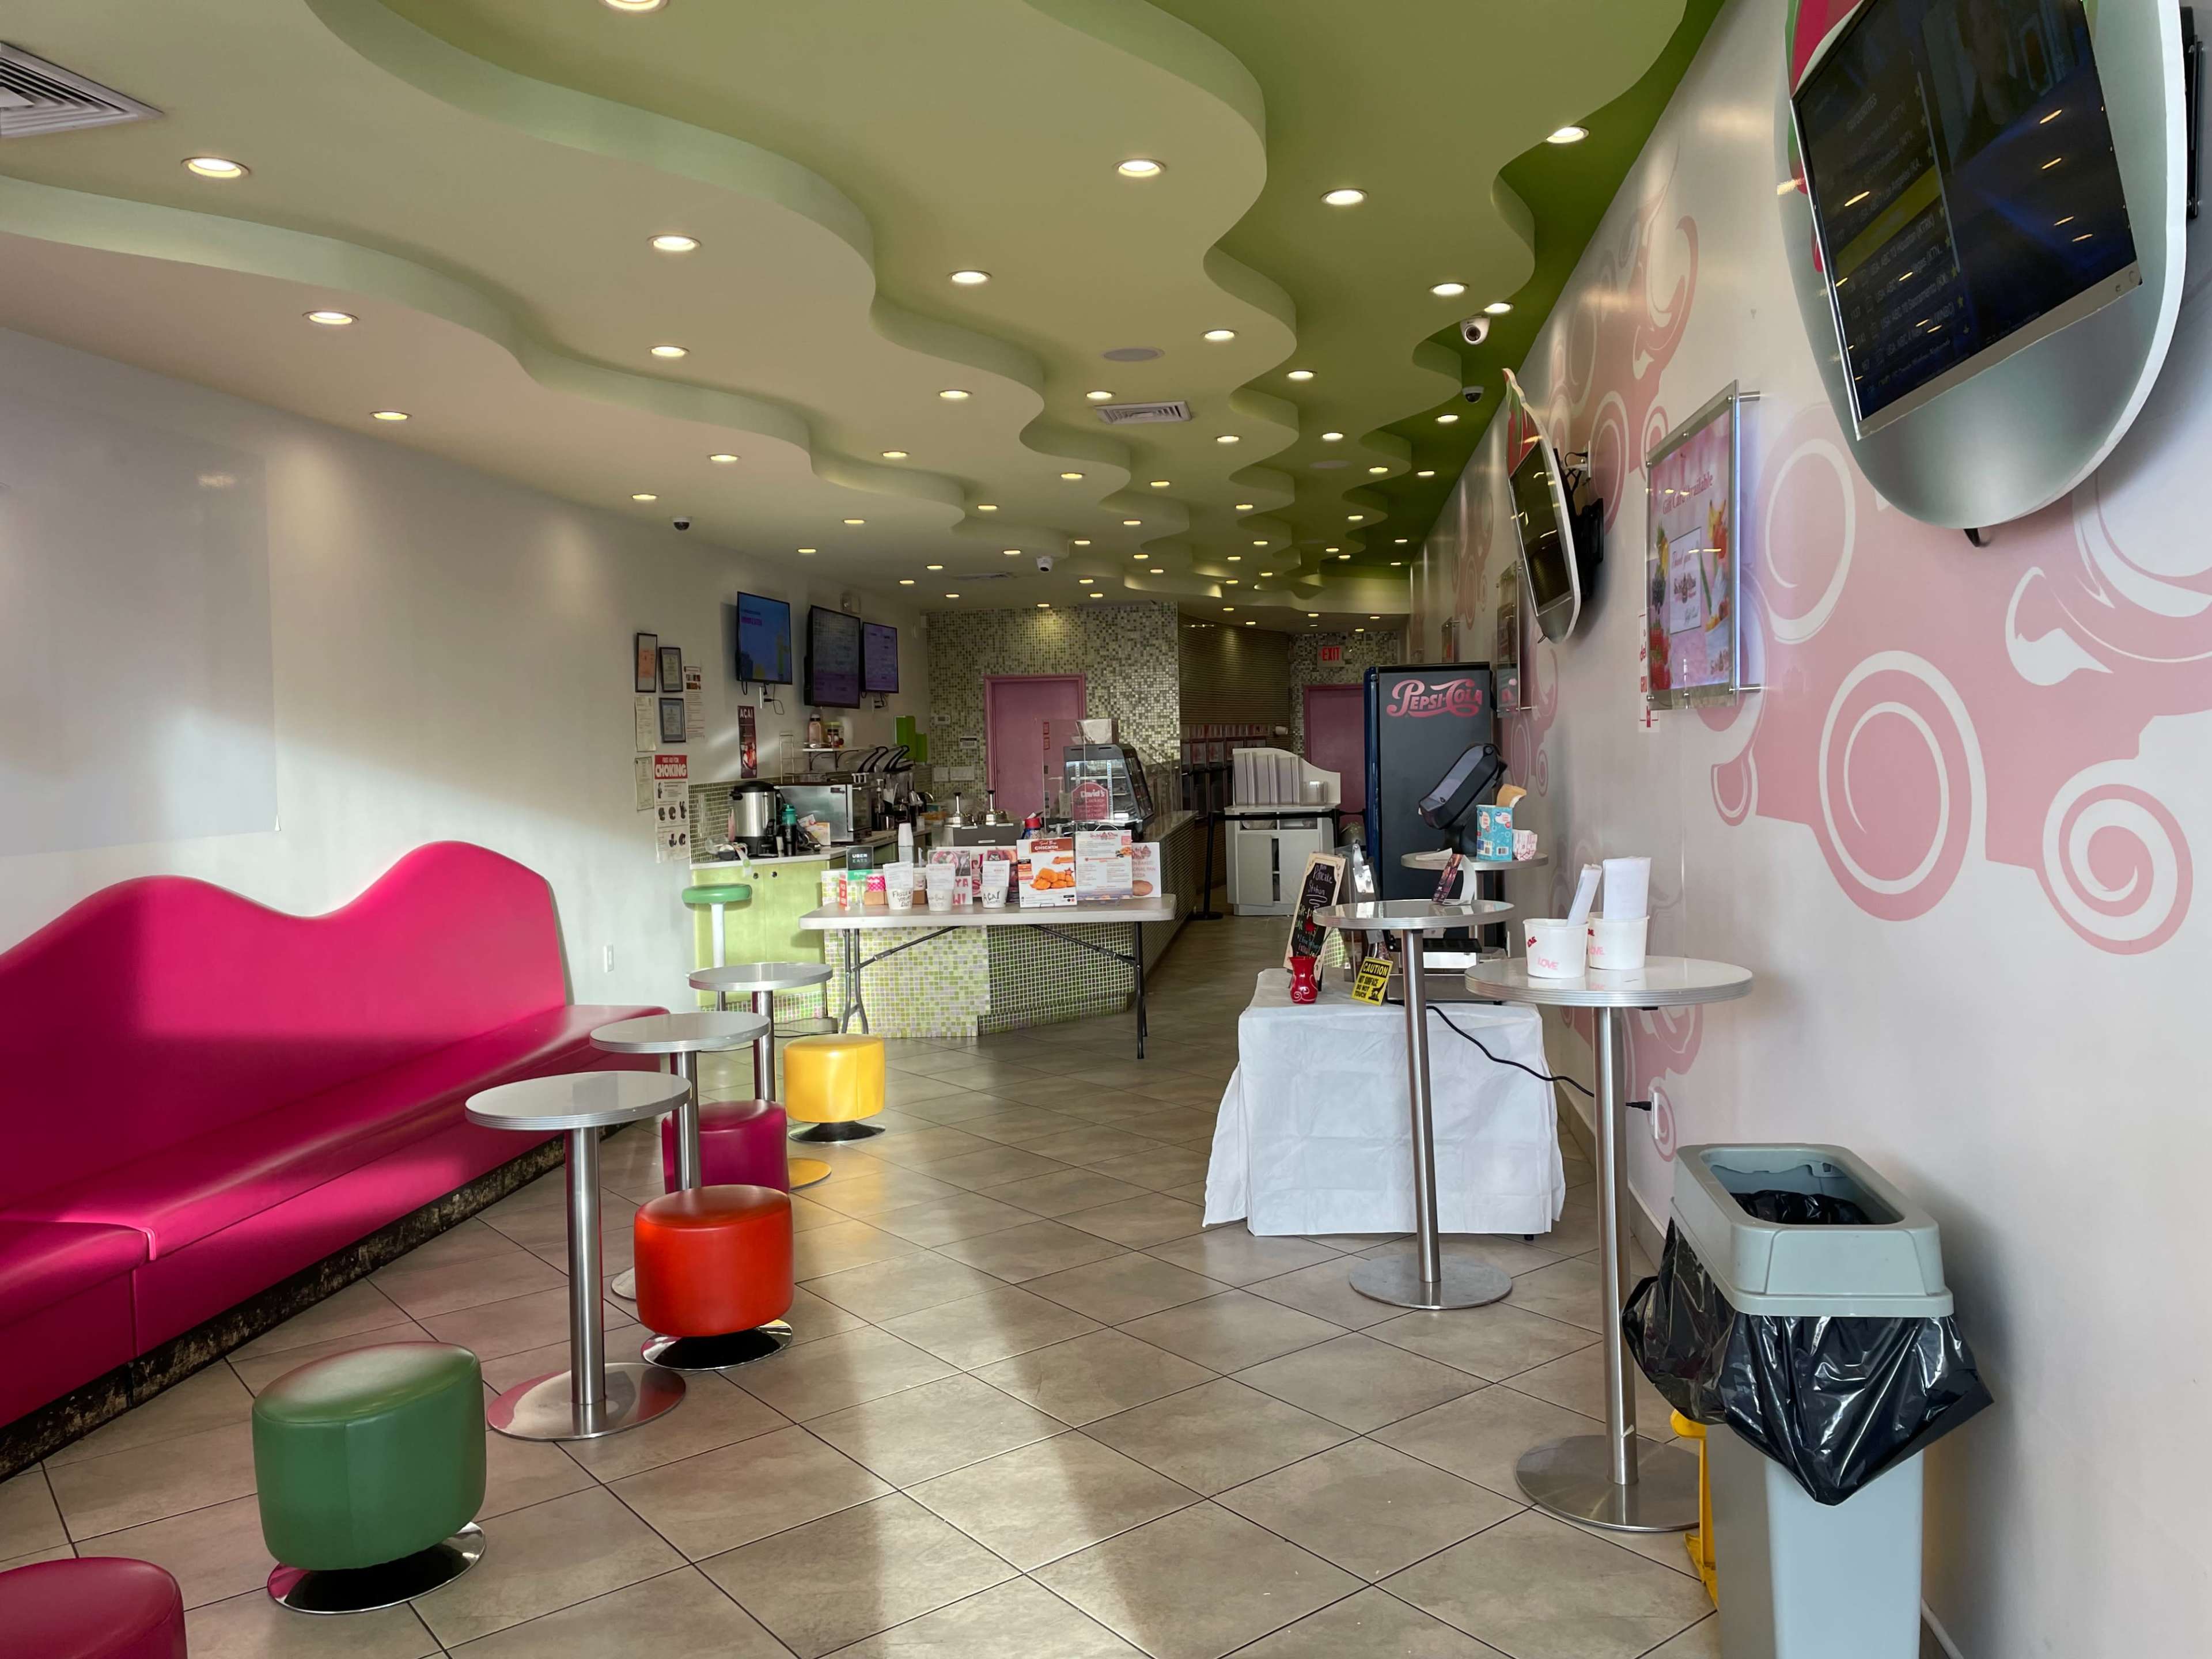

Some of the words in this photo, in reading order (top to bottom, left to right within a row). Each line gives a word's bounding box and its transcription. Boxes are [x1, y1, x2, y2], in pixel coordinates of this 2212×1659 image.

[1322, 647, 1340, 661] EXIT
[656, 763, 687, 777] CHOKING
[1080, 789, 1105, 798] David's
[1589, 945, 1605, 956] OVE
[1363, 962, 1388, 976] CAUTION
[1537, 957, 1559, 971] LOVE
